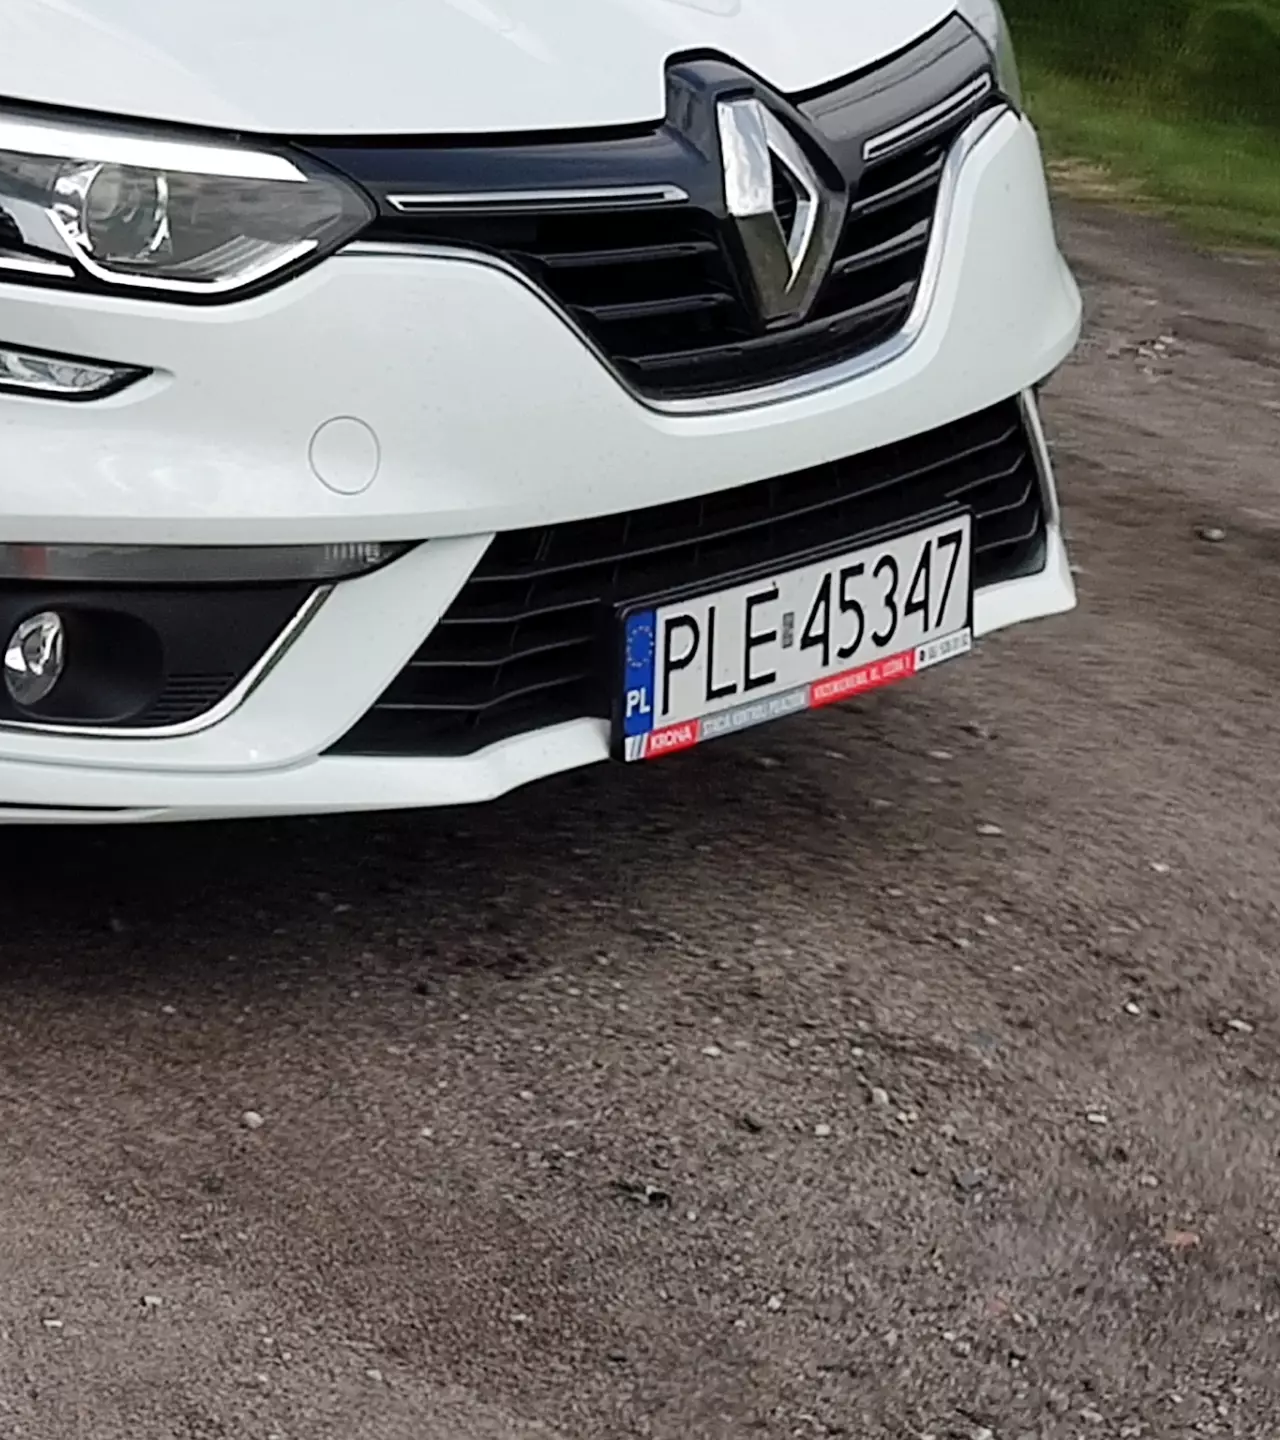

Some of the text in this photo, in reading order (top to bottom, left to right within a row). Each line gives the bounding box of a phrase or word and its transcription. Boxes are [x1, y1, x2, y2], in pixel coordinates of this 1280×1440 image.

[661, 529, 963, 716] PLE 45347
[626, 688, 651, 718] PL
[649, 725, 694, 751] KRONA
